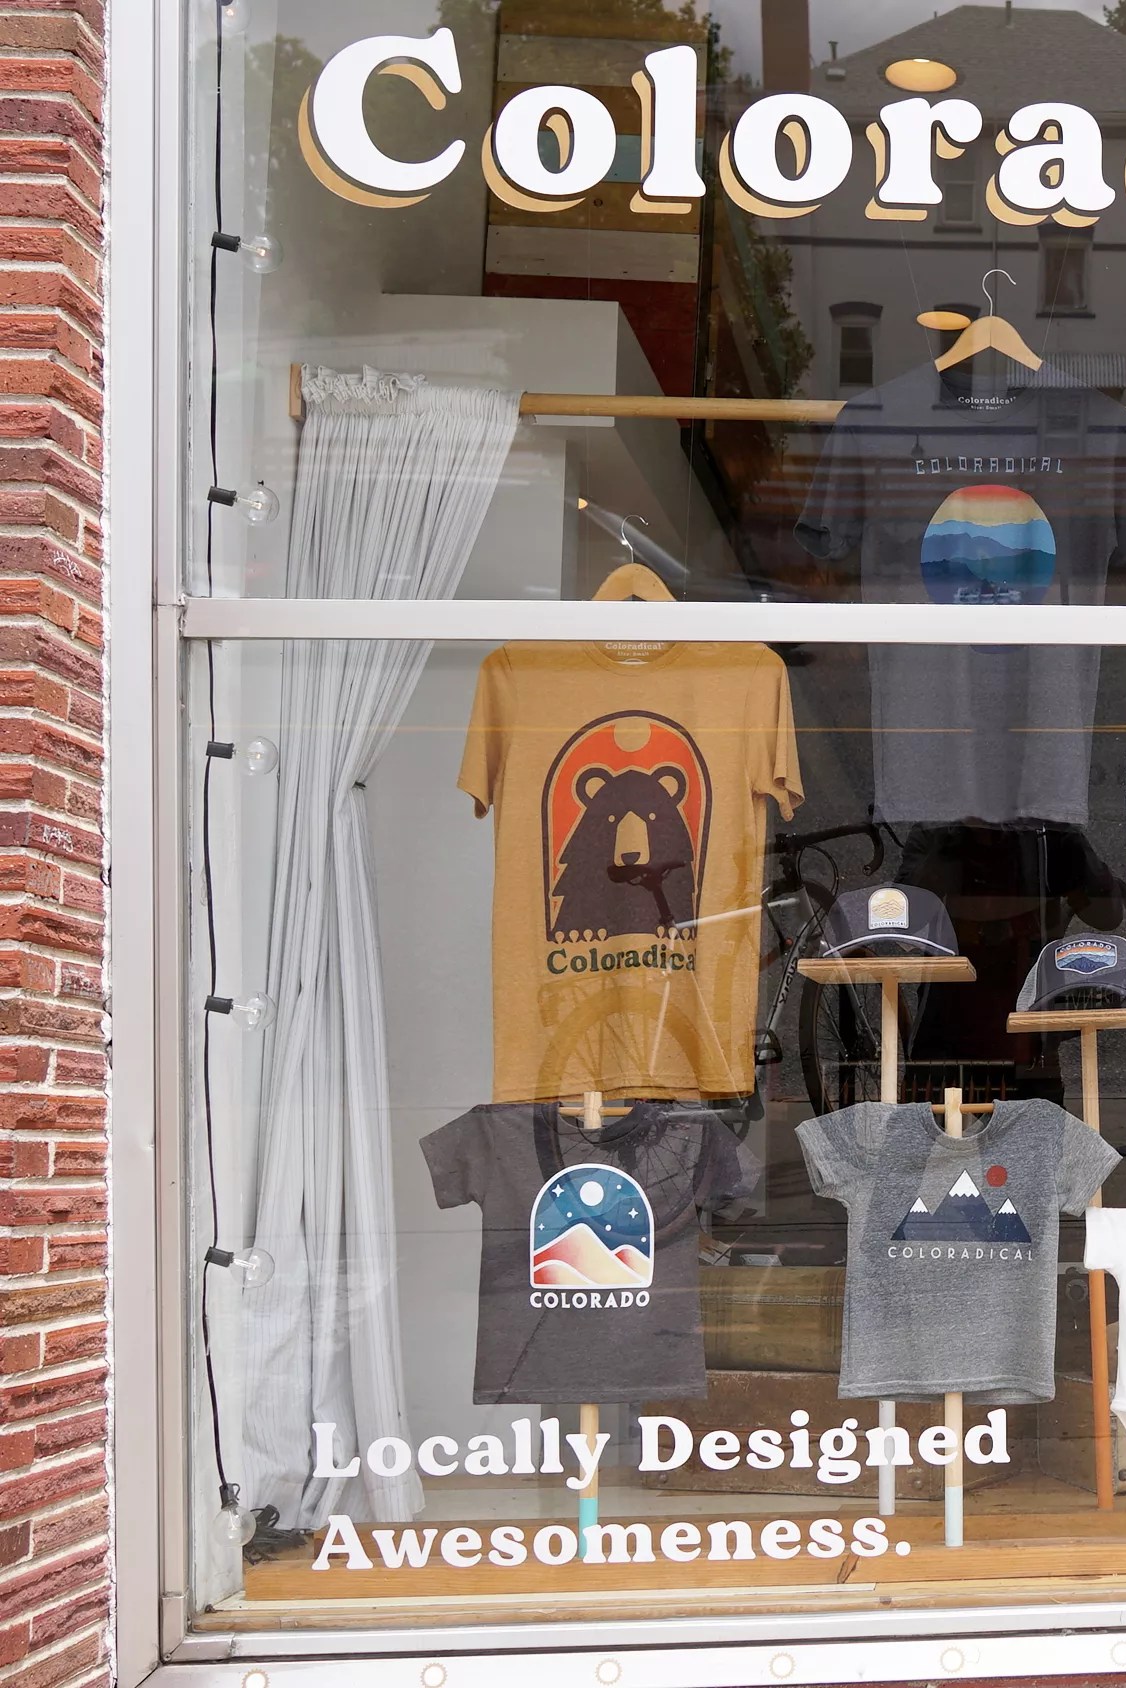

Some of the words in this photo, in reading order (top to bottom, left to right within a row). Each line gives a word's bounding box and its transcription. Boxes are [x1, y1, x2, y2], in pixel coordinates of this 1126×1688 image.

[915, 455, 1063, 475] COLORADICAL
[1059, 940, 1113, 953] COLORADO
[546, 943, 697, 975] Coloradica
[886, 1244, 1035, 1263] COLORADICAL
[529, 1290, 651, 1309] COLORADO
[312, 1417, 611, 1491] Locally
[638, 1409, 1011, 1484] Designed
[312, 1514, 911, 1571] Awesomeness.
